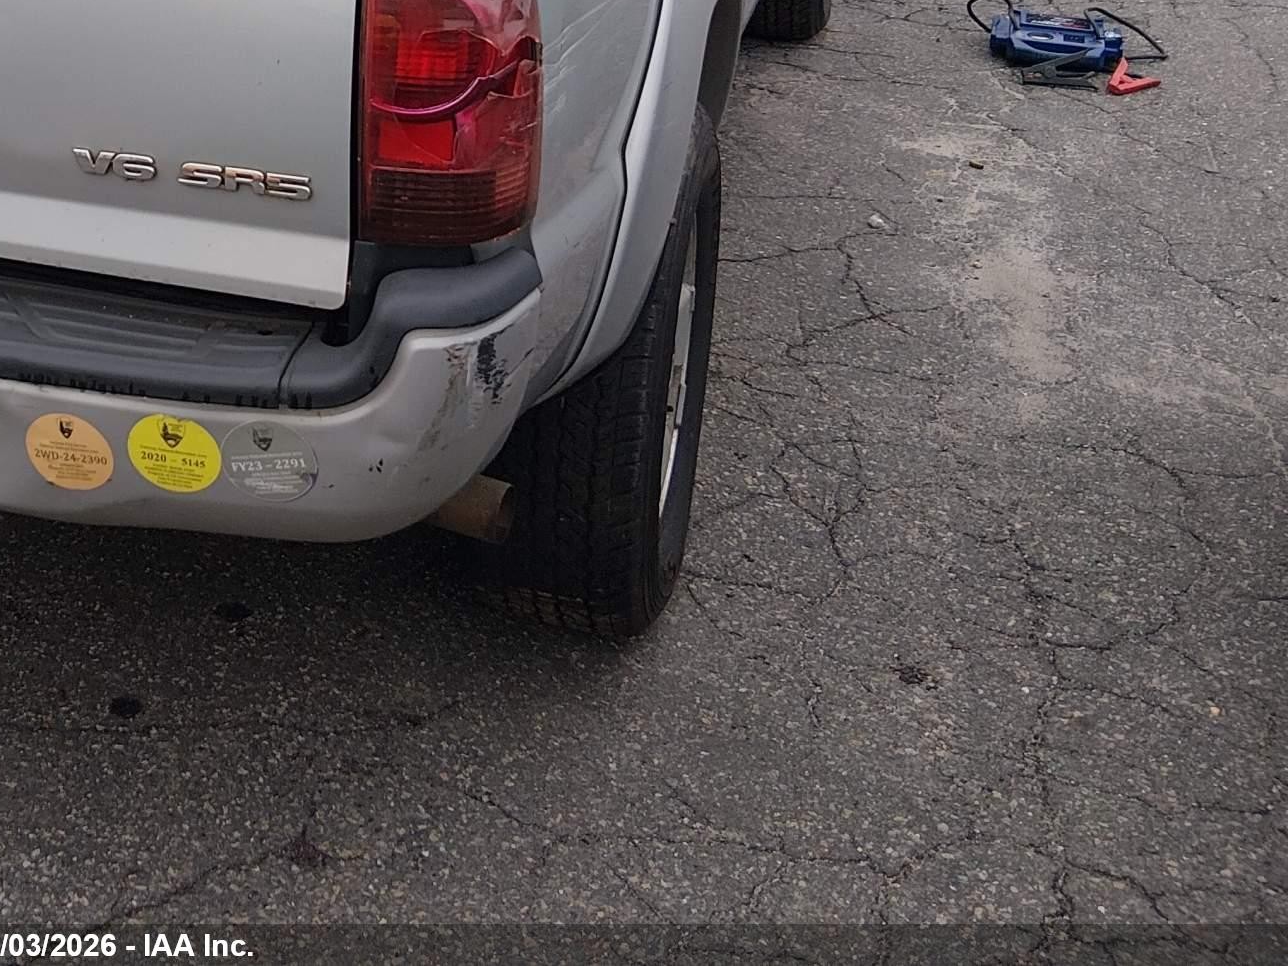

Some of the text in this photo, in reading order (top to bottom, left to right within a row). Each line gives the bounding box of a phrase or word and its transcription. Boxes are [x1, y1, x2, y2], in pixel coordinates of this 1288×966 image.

[72, 146, 314, 201] V6 SR5
[33, 448, 108, 466] 2WD-24-2390
[140, 450, 167, 463] 2020
[181, 457, 206, 469] 5145
[231, 460, 263, 472] FY23
[273, 457, 307, 470] 2291
